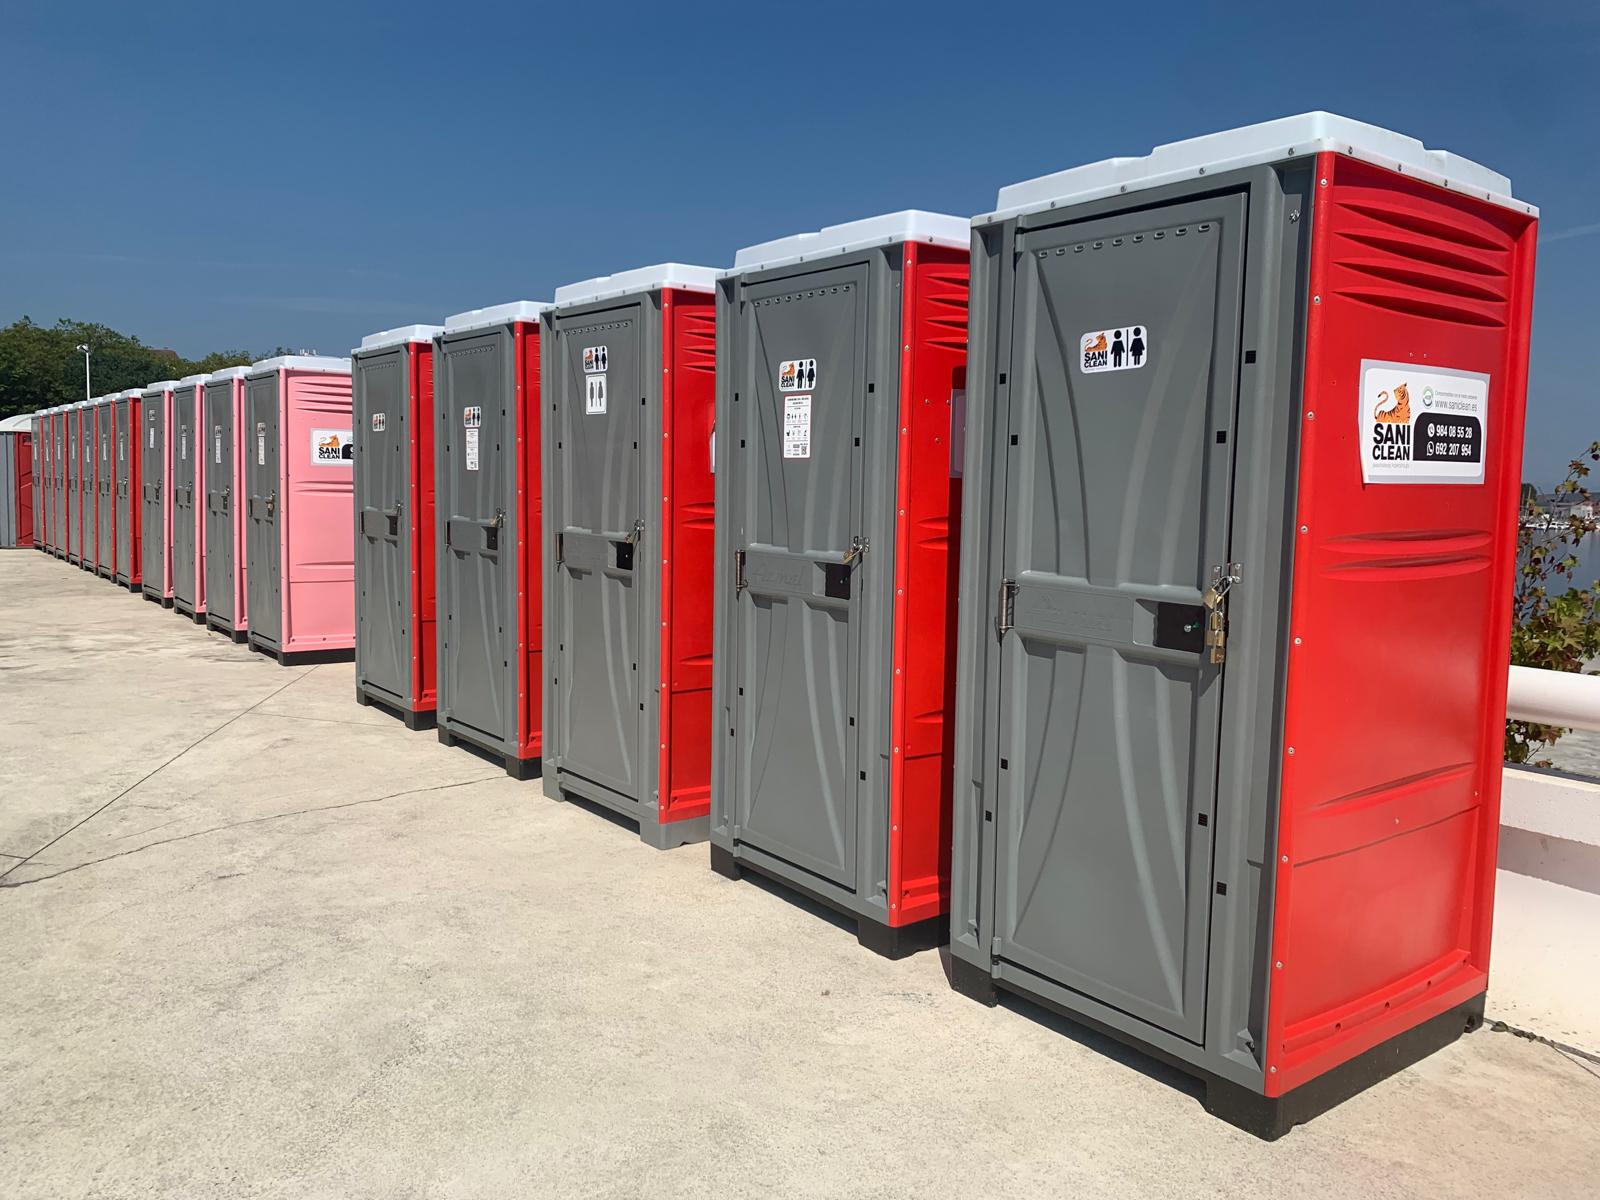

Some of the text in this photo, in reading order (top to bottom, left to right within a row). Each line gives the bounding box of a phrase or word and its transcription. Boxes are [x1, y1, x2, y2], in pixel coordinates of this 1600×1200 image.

[1084, 350, 1108, 362] SANI
[1084, 360, 1108, 369] CLEAN
[1434, 400, 1478, 412] www.saniclean.es
[1373, 423, 1410, 445] SANI
[1436, 424, 1473, 439] 984 08 55 28
[318, 447, 340, 455] SANI
[1372, 445, 1410, 461] CLEAN
[1435, 442, 1472, 456] 692 207 954
